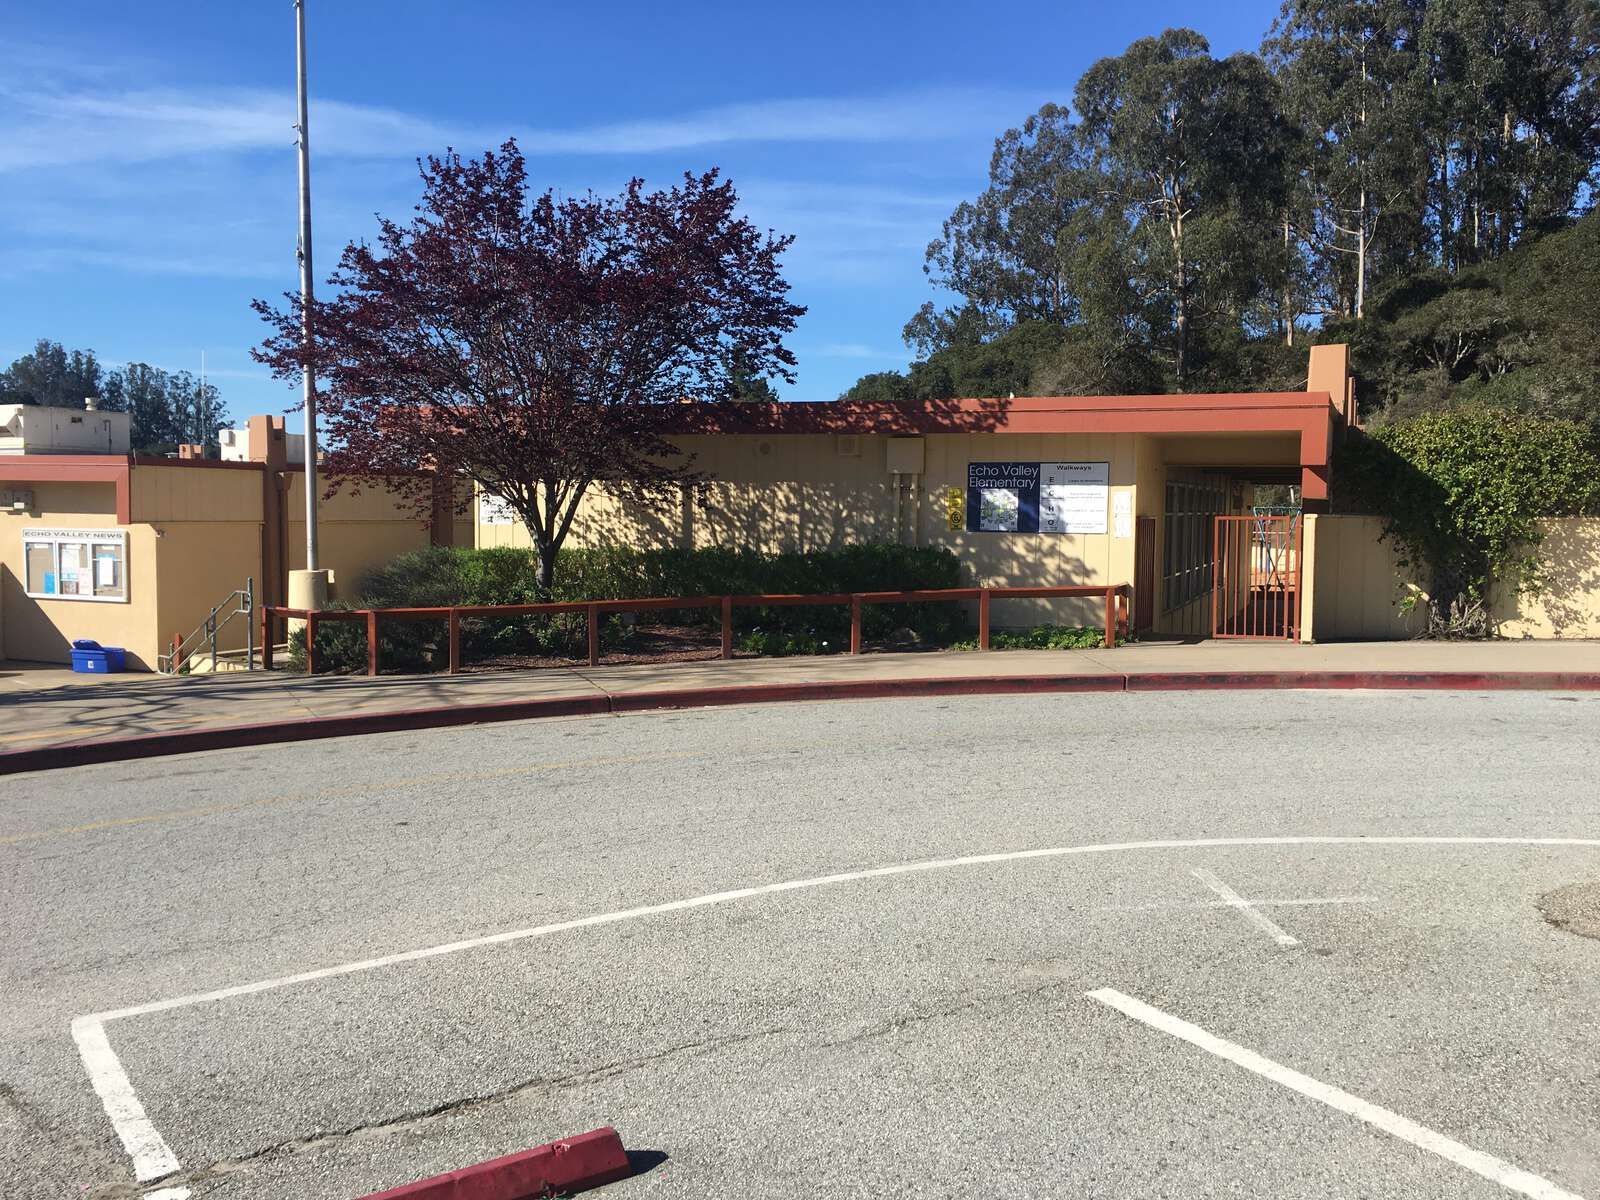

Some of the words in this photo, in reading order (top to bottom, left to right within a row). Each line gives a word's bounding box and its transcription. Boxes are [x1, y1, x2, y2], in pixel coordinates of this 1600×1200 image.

[969, 465, 999, 476] Echo
[1002, 465, 1039, 478] Valley
[969, 476, 1036, 489] Elementary
